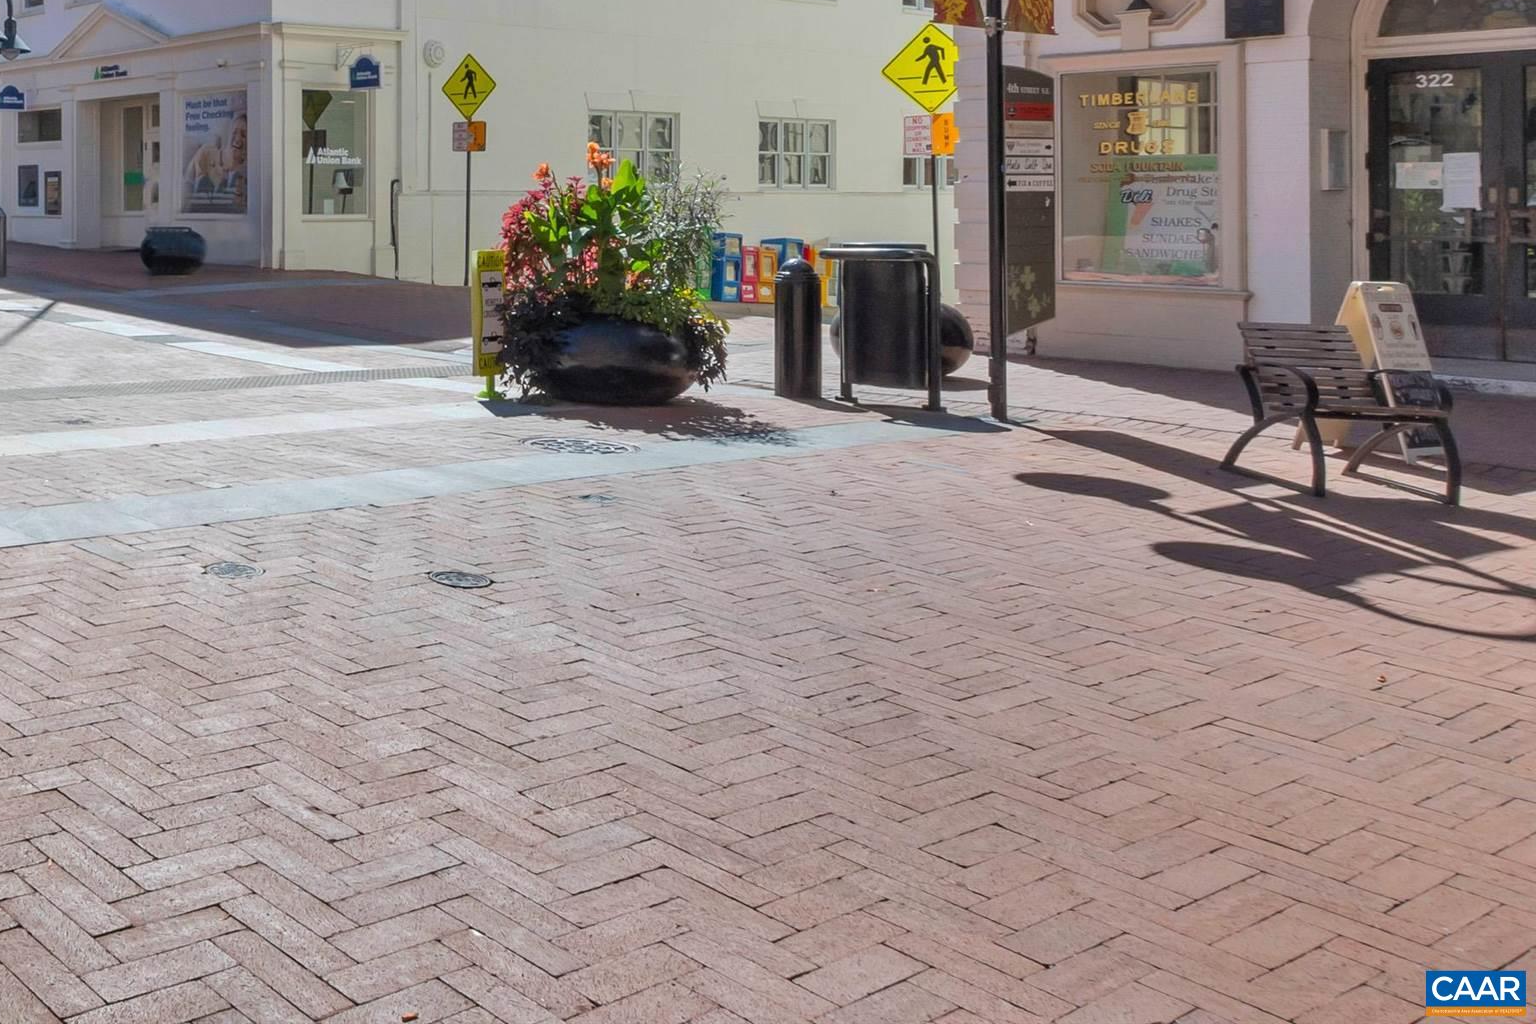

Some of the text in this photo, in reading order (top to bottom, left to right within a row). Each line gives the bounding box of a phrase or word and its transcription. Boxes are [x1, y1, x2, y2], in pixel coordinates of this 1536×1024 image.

[1415, 73, 1454, 88] 322
[1007, 83, 1019, 93] 4th
[1079, 88, 1198, 106] TIMBERAKE
[185, 98, 227, 110] Must be that
[185, 110, 234, 121] Free Checking
[317, 147, 349, 156] Atlantic
[317, 156, 362, 165] Union Bank
[1167, 187, 1198, 198] Drug
[1151, 217, 1202, 227] SHAKES
[1127, 248, 1203, 259] SANDWICHE
